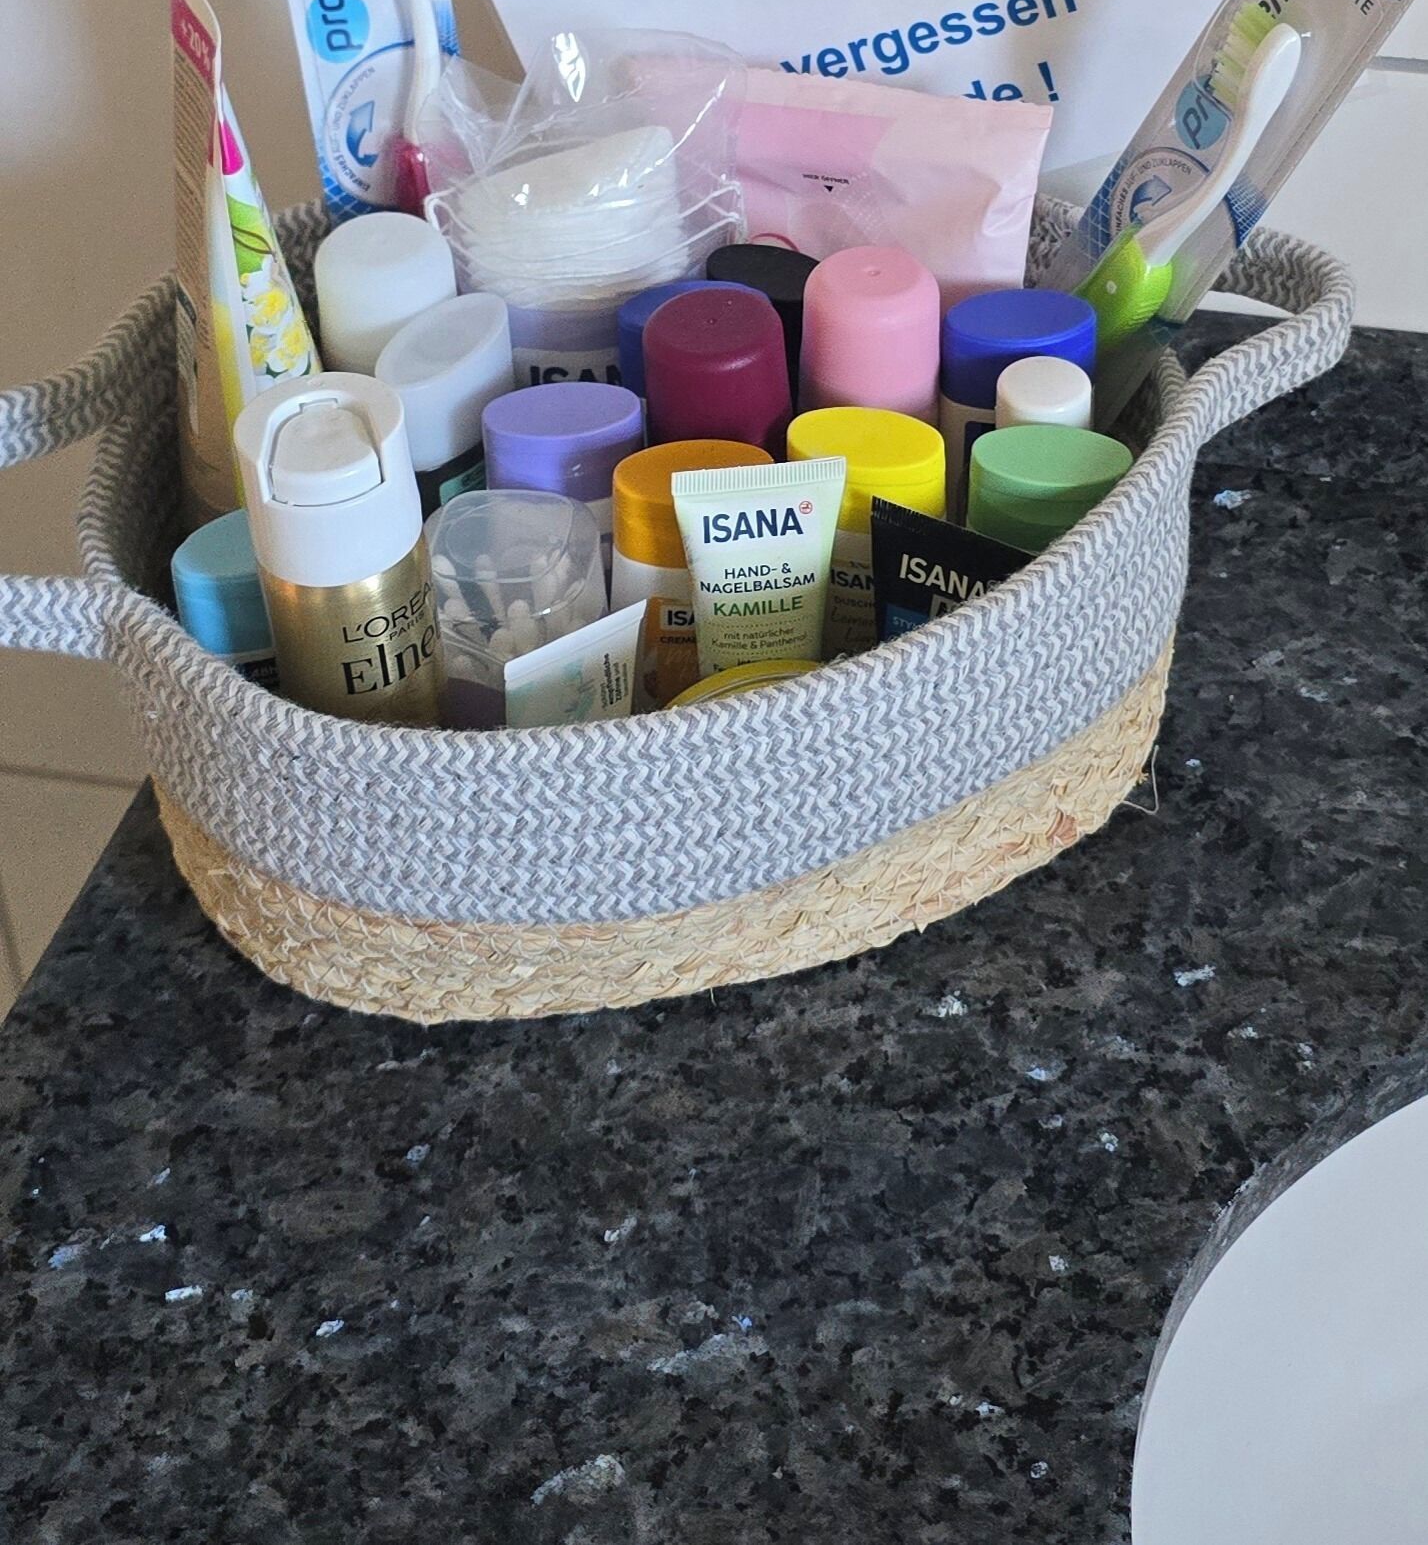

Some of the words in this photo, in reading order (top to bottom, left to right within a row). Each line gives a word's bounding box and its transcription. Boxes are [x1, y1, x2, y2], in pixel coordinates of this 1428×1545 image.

[703, 507, 804, 544] ISANA
[724, 564, 778, 580] HAND-
[781, 562, 792, 574] &
[899, 553, 986, 600] ISANA
[699, 572, 816, 594] NAGELBALSAM
[713, 595, 804, 617] KAMILLE
[711, 638, 748, 650] Kamille
[750, 641, 758, 649] &
[724, 631, 740, 640] mit
[742, 626, 795, 641] natürlicher
